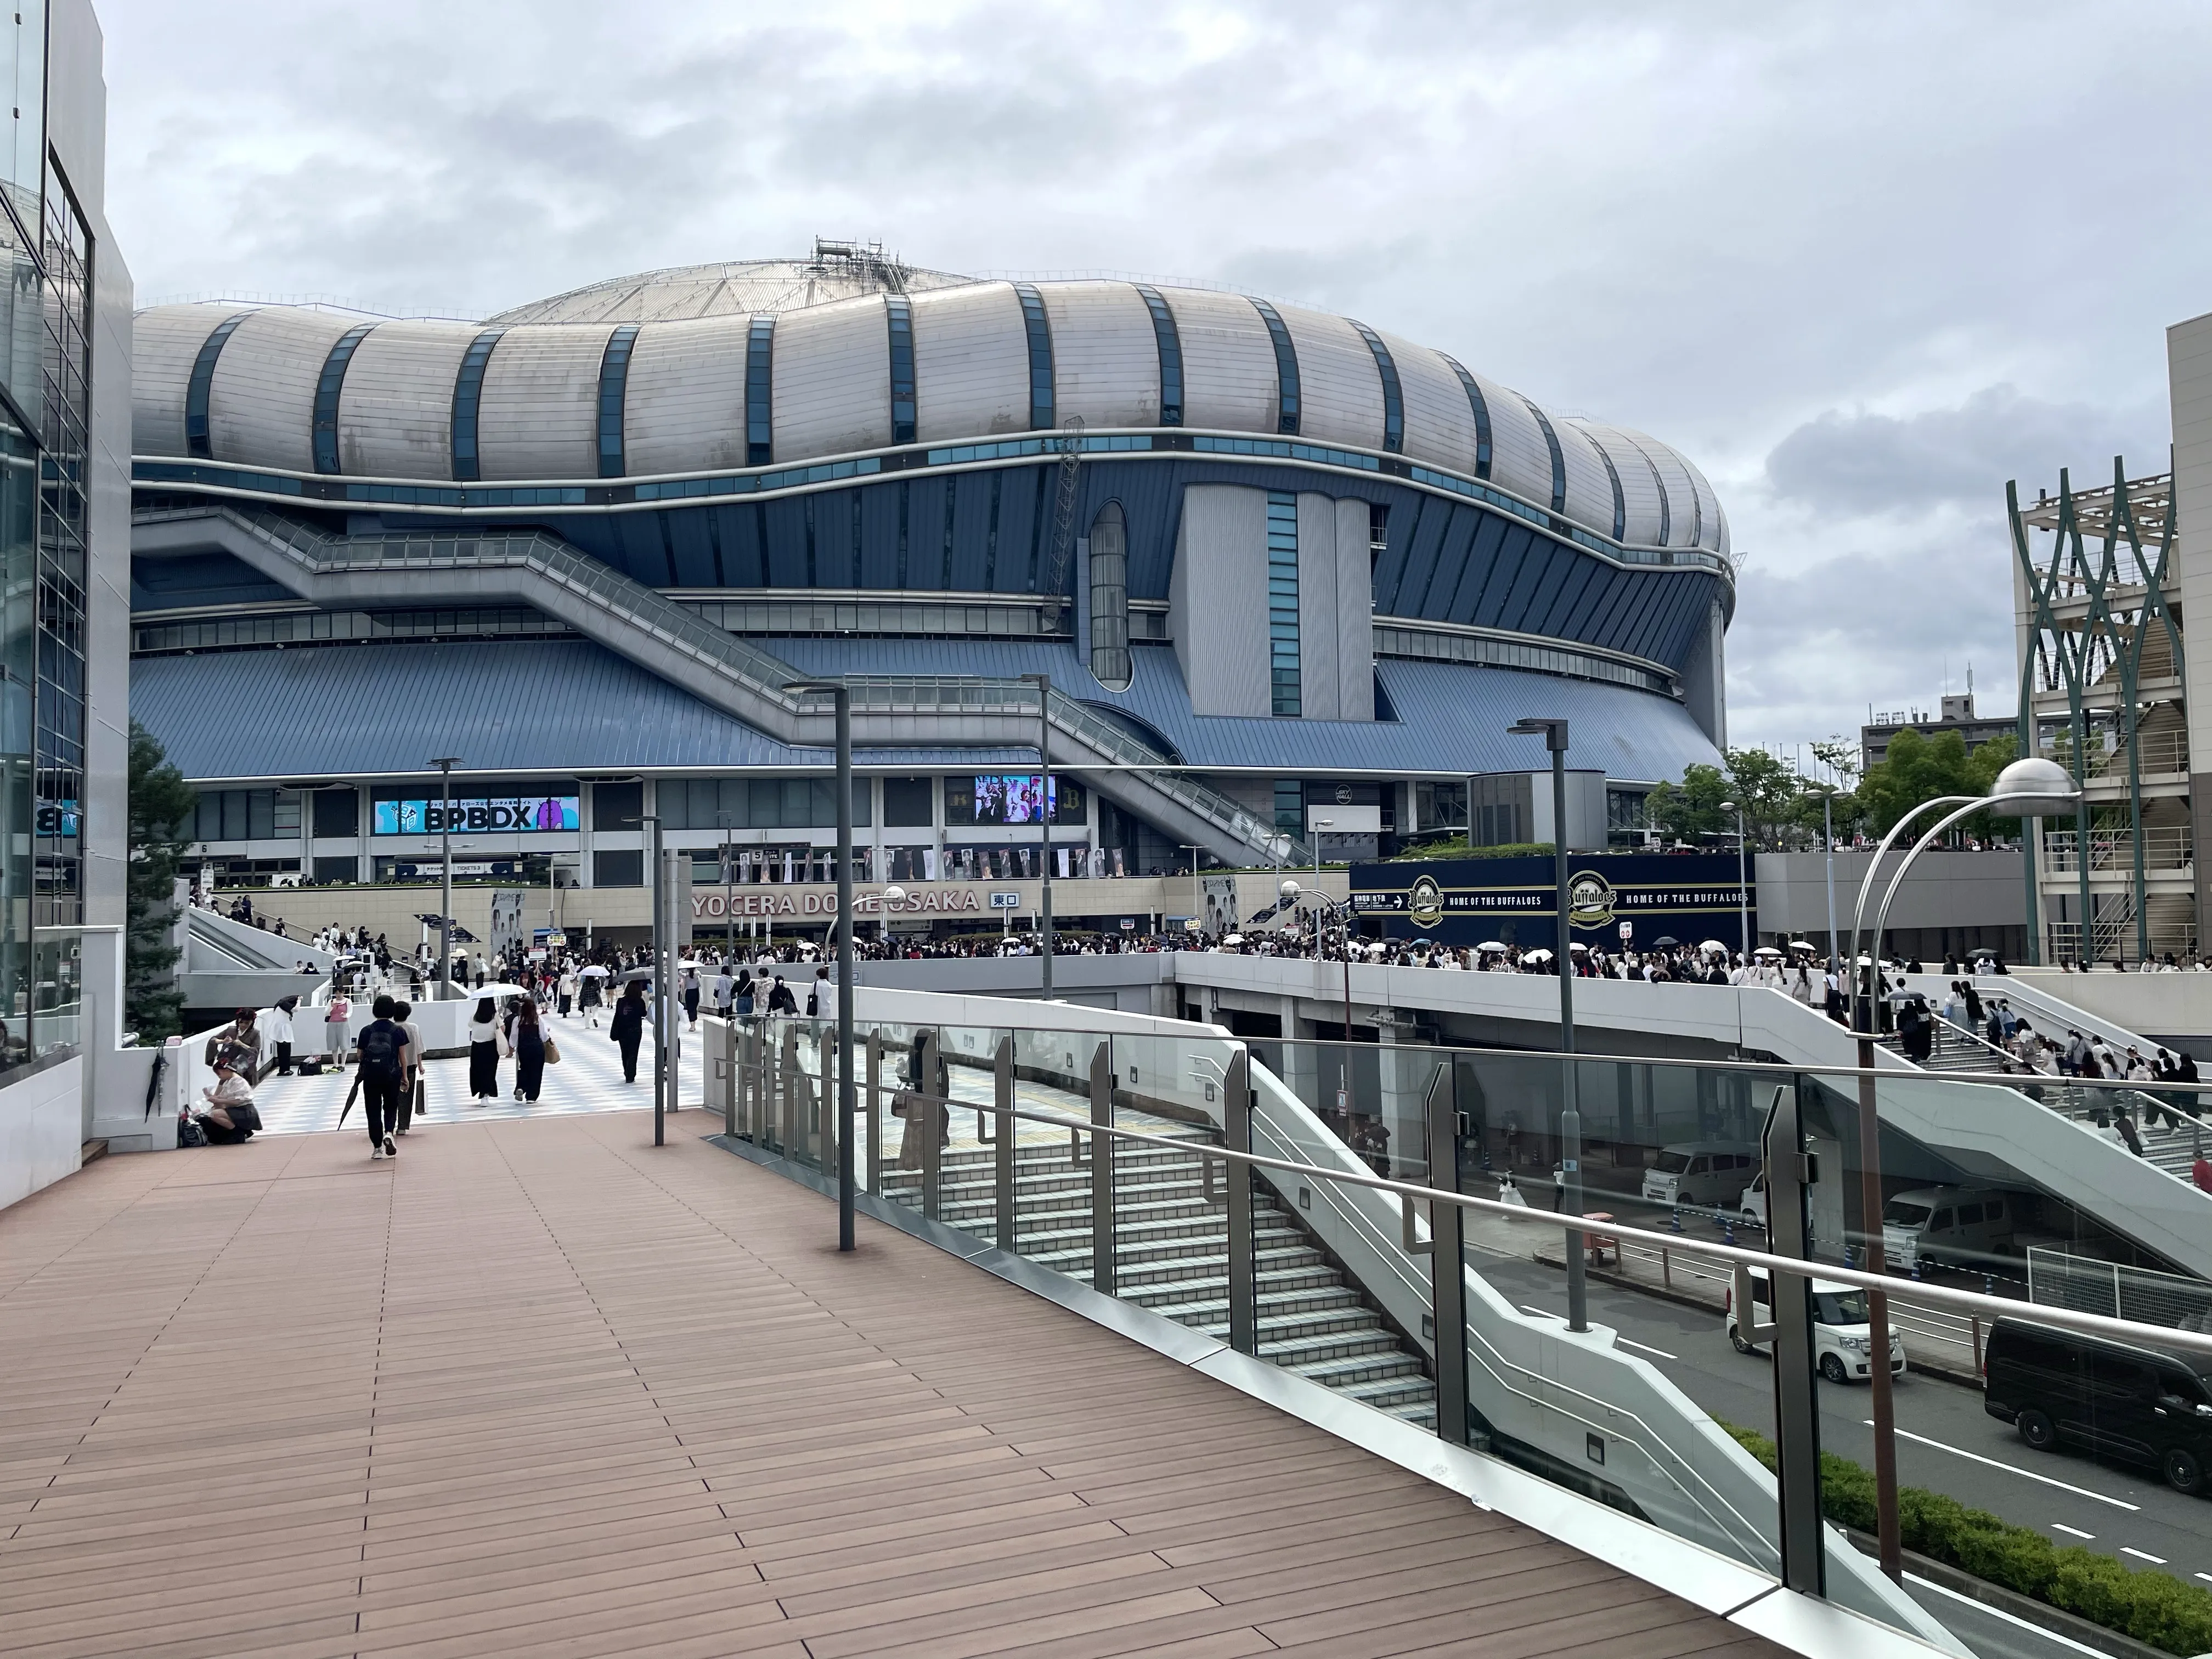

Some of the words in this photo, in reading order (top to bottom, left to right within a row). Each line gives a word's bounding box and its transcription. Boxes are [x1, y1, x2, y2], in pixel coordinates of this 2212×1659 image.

[425, 806, 531, 830] BPBDX
[692, 894, 795, 916] YOCERA
[994, 895, 1017, 906] 東口
[1409, 890, 1443, 907] Buffaloes
[1471, 897, 1479, 905] OF
[1481, 897, 1495, 905] THE
[1497, 896, 1541, 905] BUFFALOES
[1627, 895, 1653, 904] HOME
[1657, 894, 1668, 903] OF
[1672, 894, 1690, 902] THE
